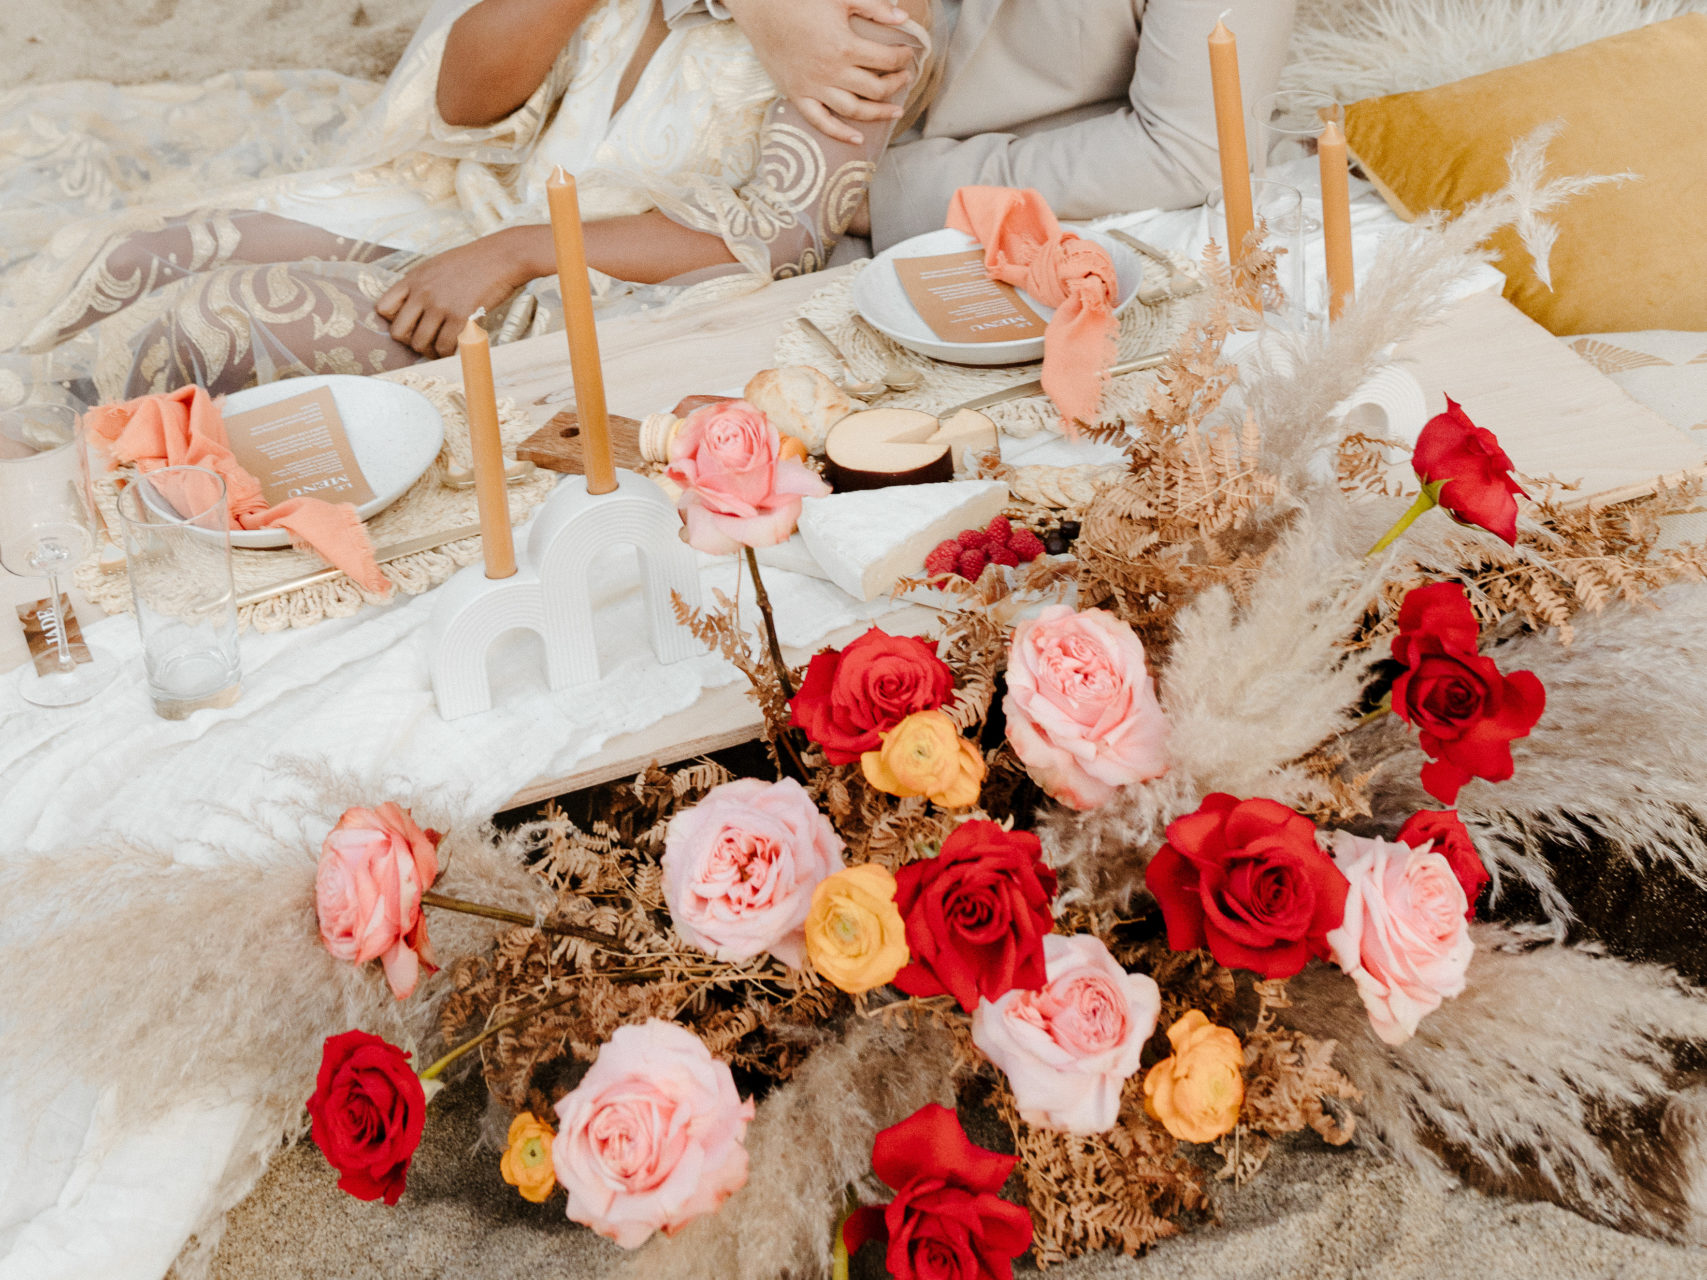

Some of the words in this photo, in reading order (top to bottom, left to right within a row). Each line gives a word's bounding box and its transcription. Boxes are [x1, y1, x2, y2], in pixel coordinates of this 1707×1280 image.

[969, 314, 1027, 332] MENU
[287, 473, 351, 498] MENU
[334, 482, 353, 492] LE
